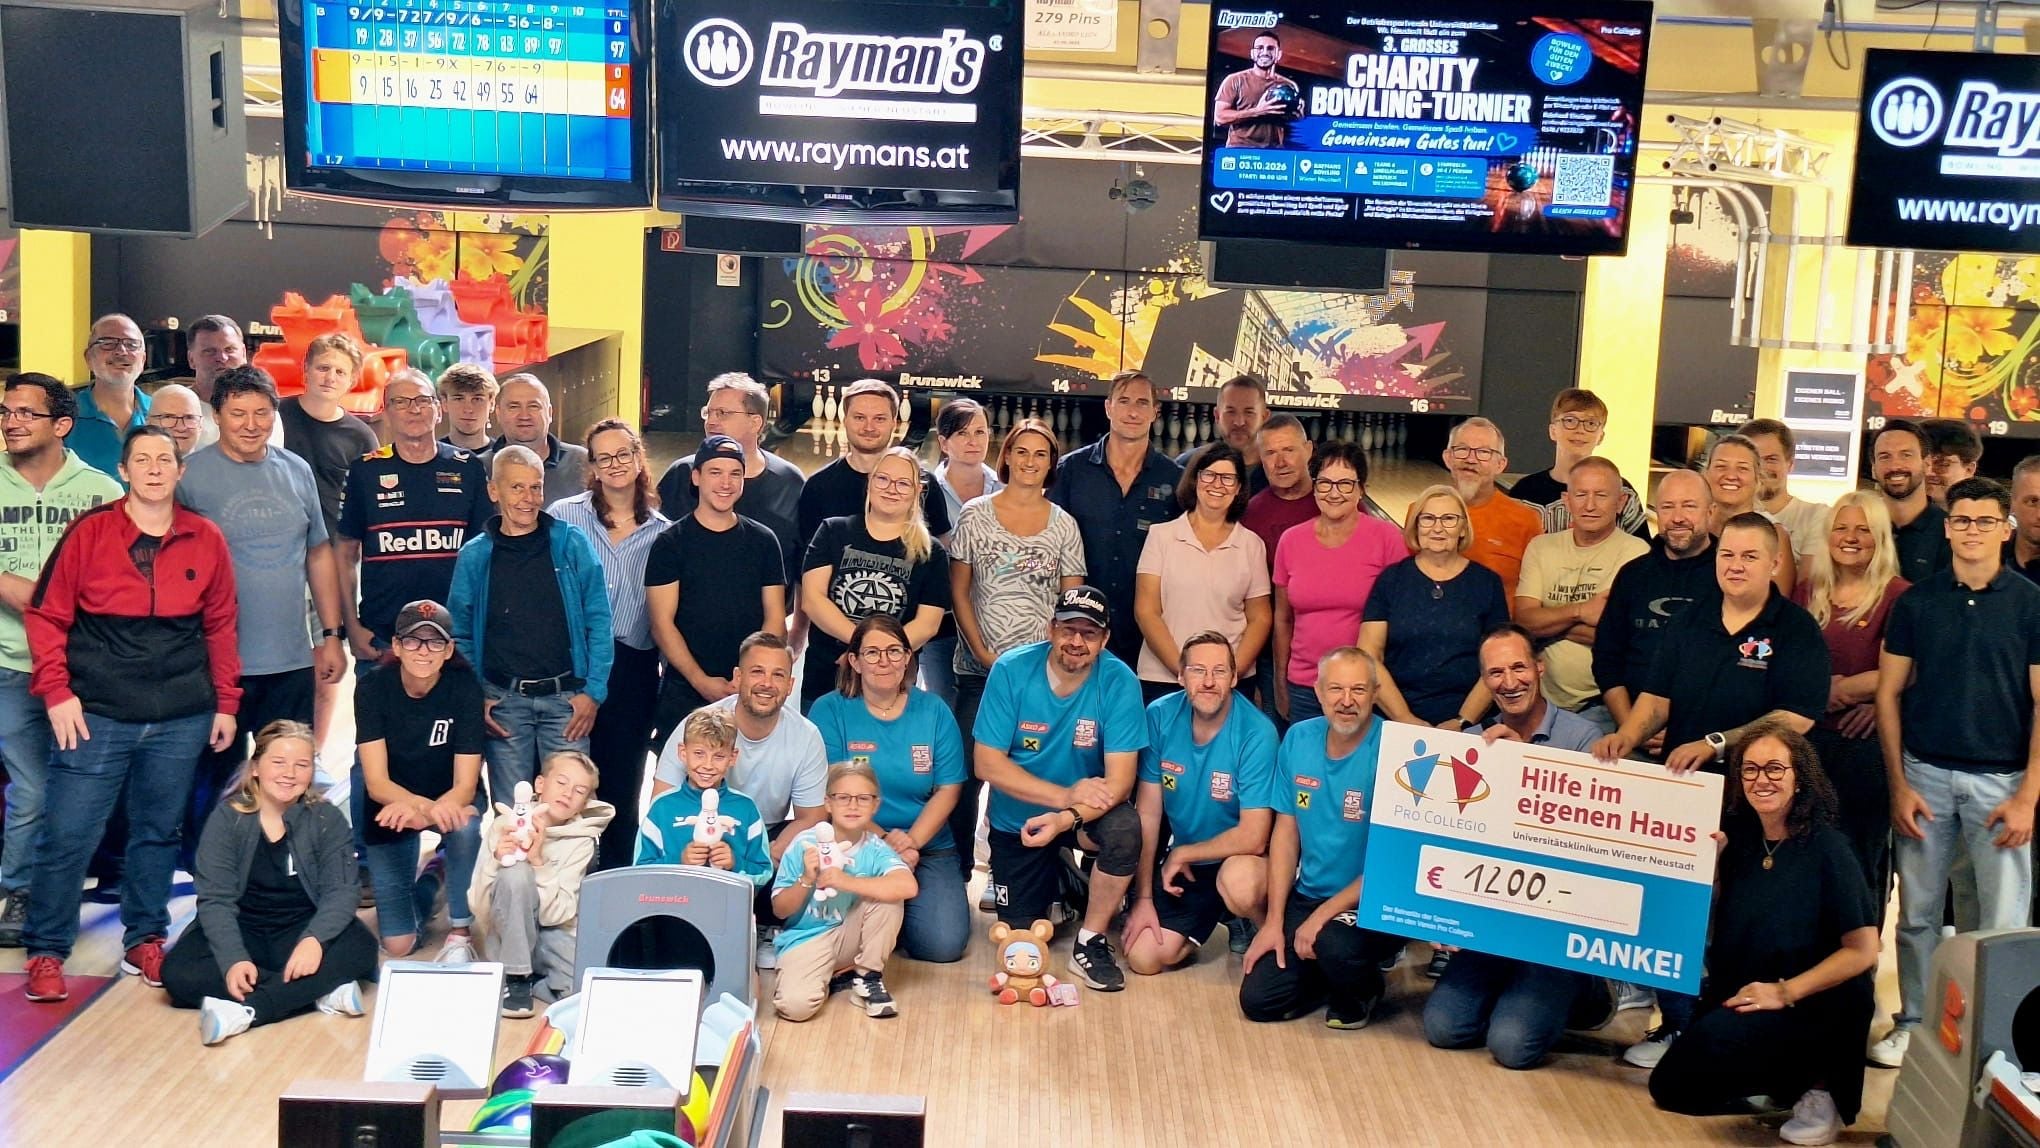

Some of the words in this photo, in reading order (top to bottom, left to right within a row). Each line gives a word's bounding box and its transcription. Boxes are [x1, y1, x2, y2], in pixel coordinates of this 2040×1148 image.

[573, 7, 584, 16] 10
[1035, 12, 1063, 23] 279
[1069, 12, 1101, 25] Pins
[1218, 10, 1278, 28] Rayman's
[355, 28, 369, 45] 19
[404, 30, 418, 48] 37
[428, 32, 443, 49] 56
[452, 33, 466, 50] 72
[610, 41, 625, 58] 97
[1383, 36, 1397, 53] 3.
[1401, 38, 1459, 55] GROSSES
[1551, 38, 1582, 51] BOWLEN
[450, 59, 458, 69] X
[763, 25, 983, 95] Rayman's
[1549, 54, 1574, 65] GUTEN
[1347, 54, 1480, 92] CHARITY
[360, 76, 367, 96] 9
[382, 77, 393, 98] 15
[406, 78, 417, 99] 16
[430, 79, 443, 100] 25
[453, 81, 466, 102] 42
[476, 82, 490, 102] 49
[501, 83, 514, 103] 55
[525, 84, 538, 105] 64
[610, 87, 625, 110] 64
[1311, 86, 1531, 124] BOWLING-TURNIER
[1948, 85, 2040, 154] Ray
[1321, 129, 1411, 149] Gemeinsam
[1416, 133, 1460, 151] Gutes
[1462, 134, 1495, 151] tun!
[721, 138, 969, 171] www.raymans.at
[1238, 161, 1287, 171] 03.10.2026
[167, 317, 179, 330] 9
[249, 321, 284, 335] Brun
[811, 369, 831, 383] 13
[899, 372, 984, 389] Brunswick
[1051, 379, 1069, 393] 14
[1170, 386, 1189, 401] 15
[1265, 392, 1341, 410] runswick
[1410, 399, 1429, 414] 16
[1867, 416, 1885, 430] 18
[1988, 421, 2008, 435] 19
[13, 526, 35, 534] THE
[379, 528, 422, 552] Red
[426, 528, 464, 550] Bull
[8, 557, 35, 572] Blue
[1521, 766, 1583, 798] Hilfe
[1589, 778, 1622, 804] im
[1517, 796, 1622, 829] eigenen
[1629, 811, 1697, 844] Haus
[1512, 831, 1609, 857] Universitätsklinikum
[1611, 849, 1648, 864] Wiener
[1649, 856, 1696, 872] Neustadt
[1426, 866, 1445, 890] €
[640, 893, 689, 904] Brunswick
[1566, 933, 1682, 979] DANKE!
